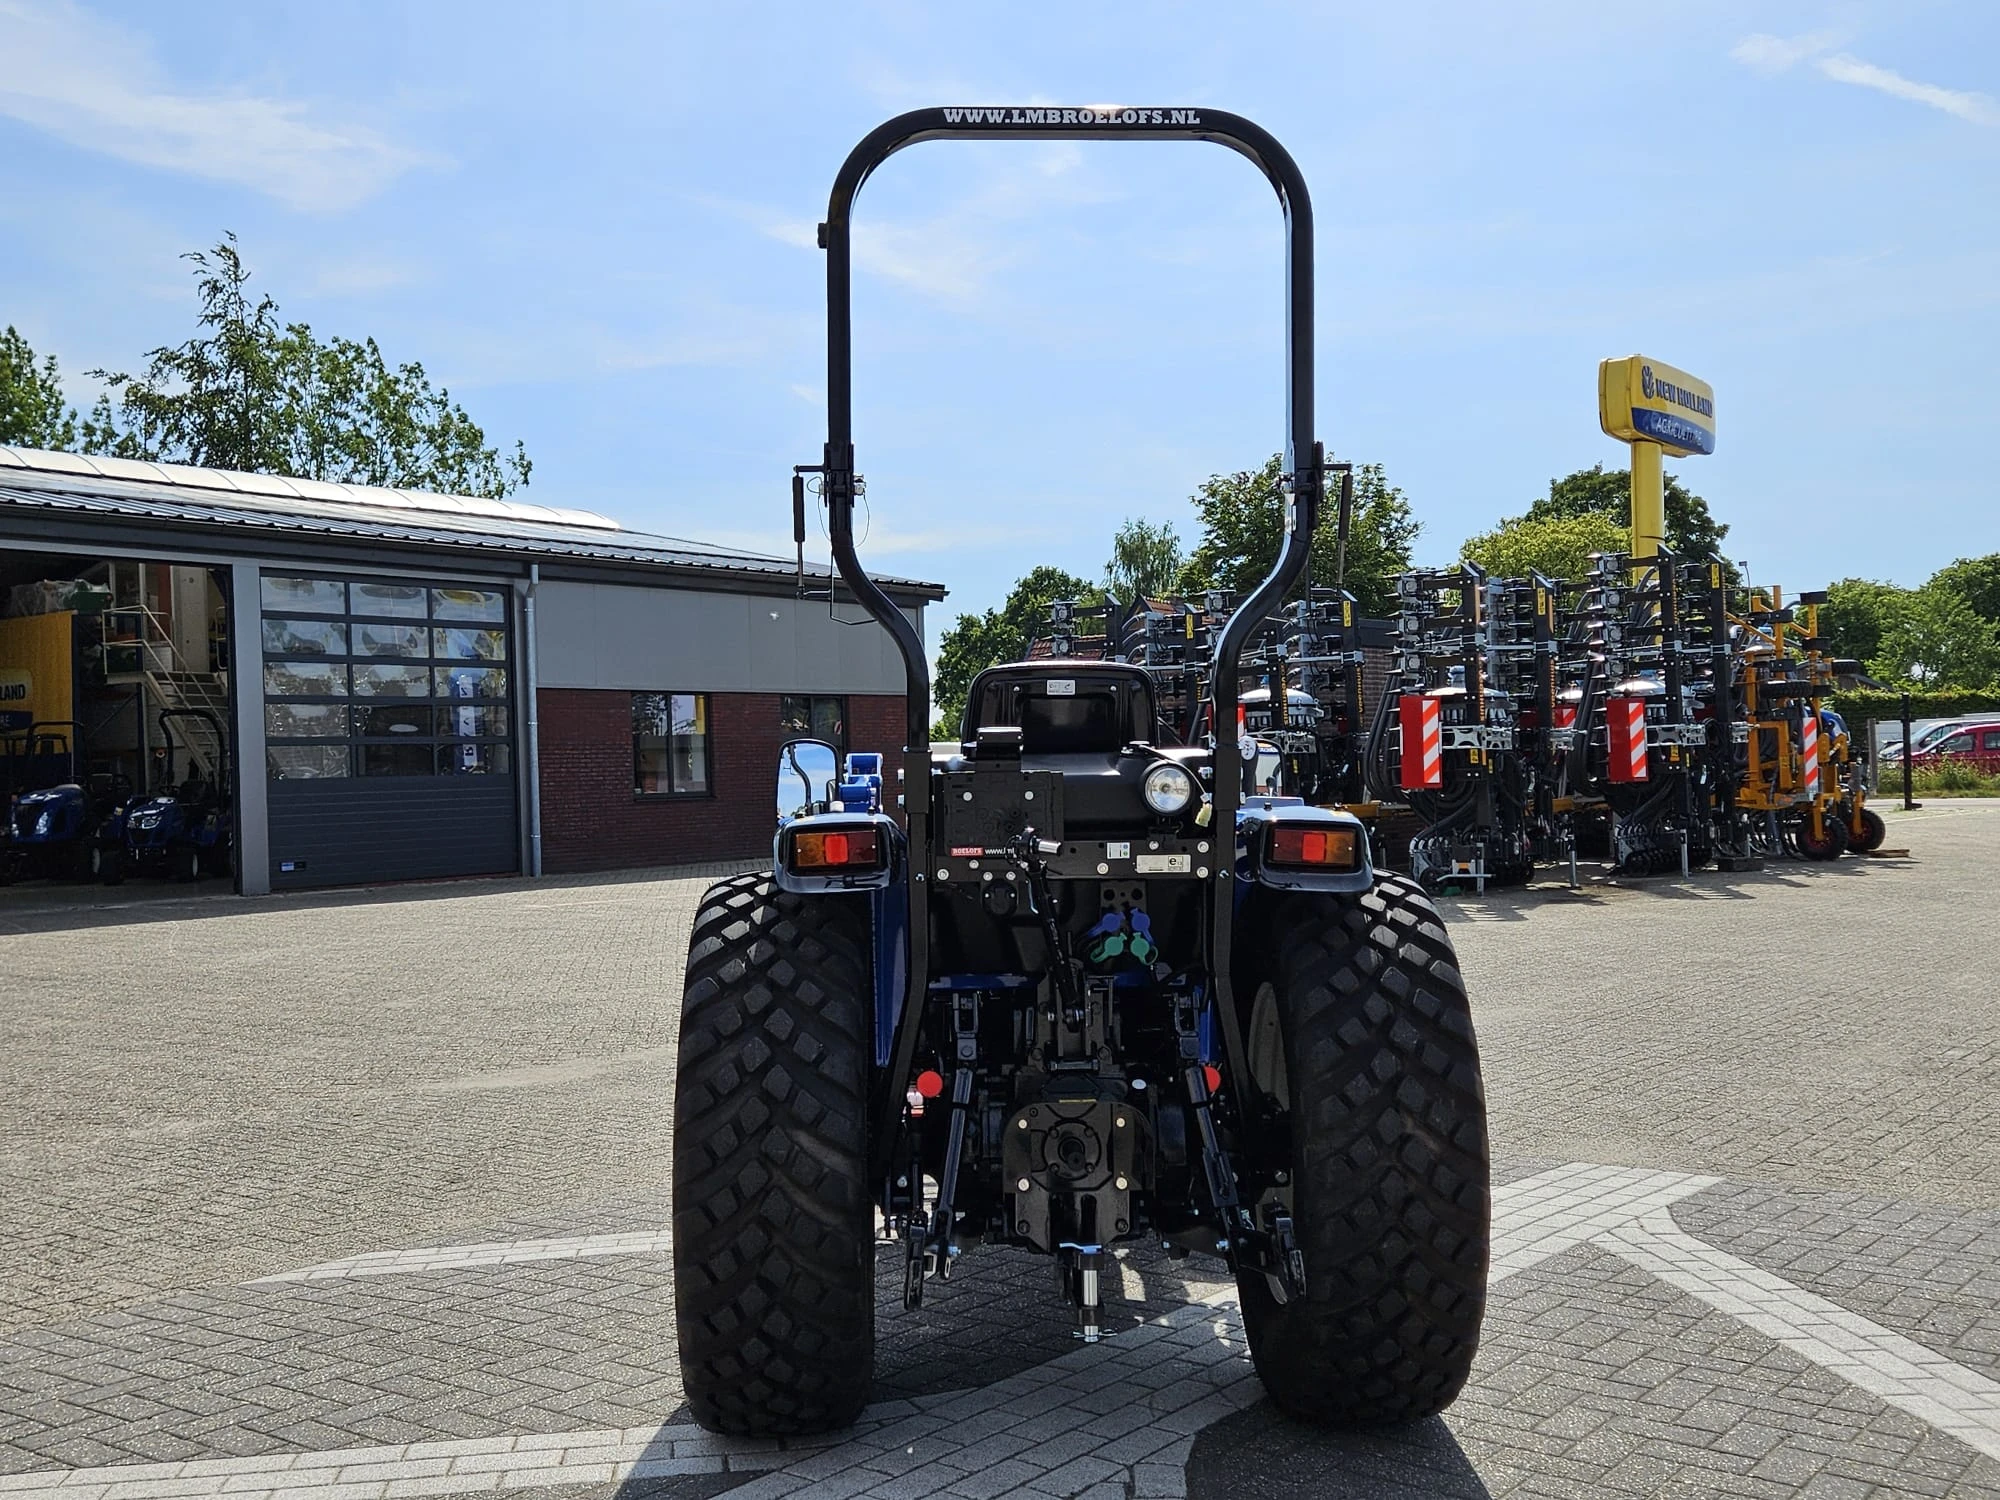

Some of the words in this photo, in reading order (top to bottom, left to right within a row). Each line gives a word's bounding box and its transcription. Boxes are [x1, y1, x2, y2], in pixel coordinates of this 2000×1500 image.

[943, 108, 1200, 124] WWW.LMBROELOFS.NL
[1655, 378, 1676, 403] NEW
[1677, 387, 1713, 418] HOLLAND
